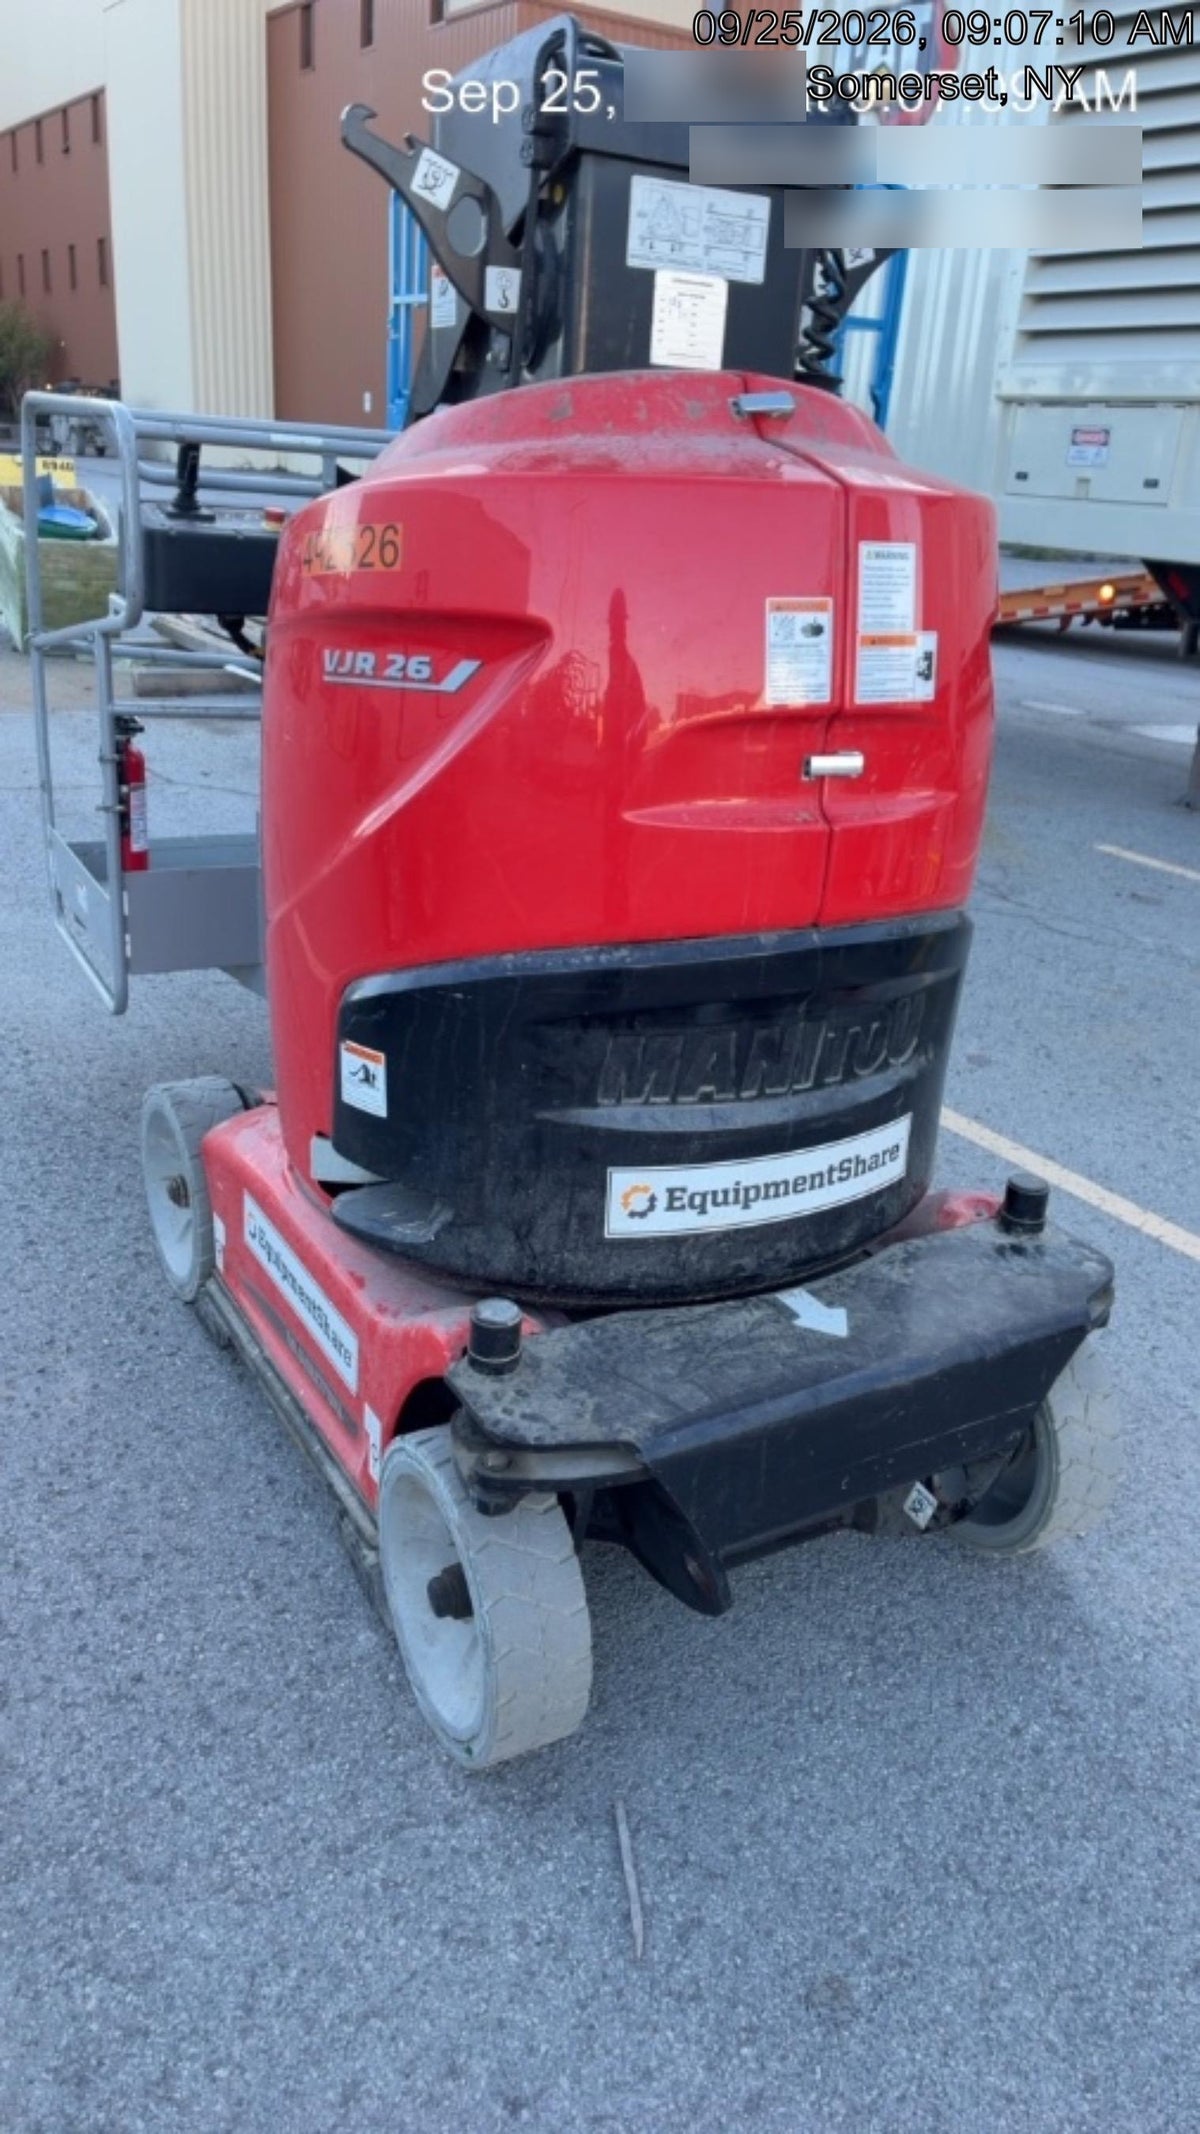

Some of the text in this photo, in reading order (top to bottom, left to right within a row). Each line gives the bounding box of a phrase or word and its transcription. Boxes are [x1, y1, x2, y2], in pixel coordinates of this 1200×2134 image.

[323, 648, 432, 680] VJR 26
[597, 995, 922, 1105] MANITOU
[664, 1142, 900, 1215] EquipmentShare
